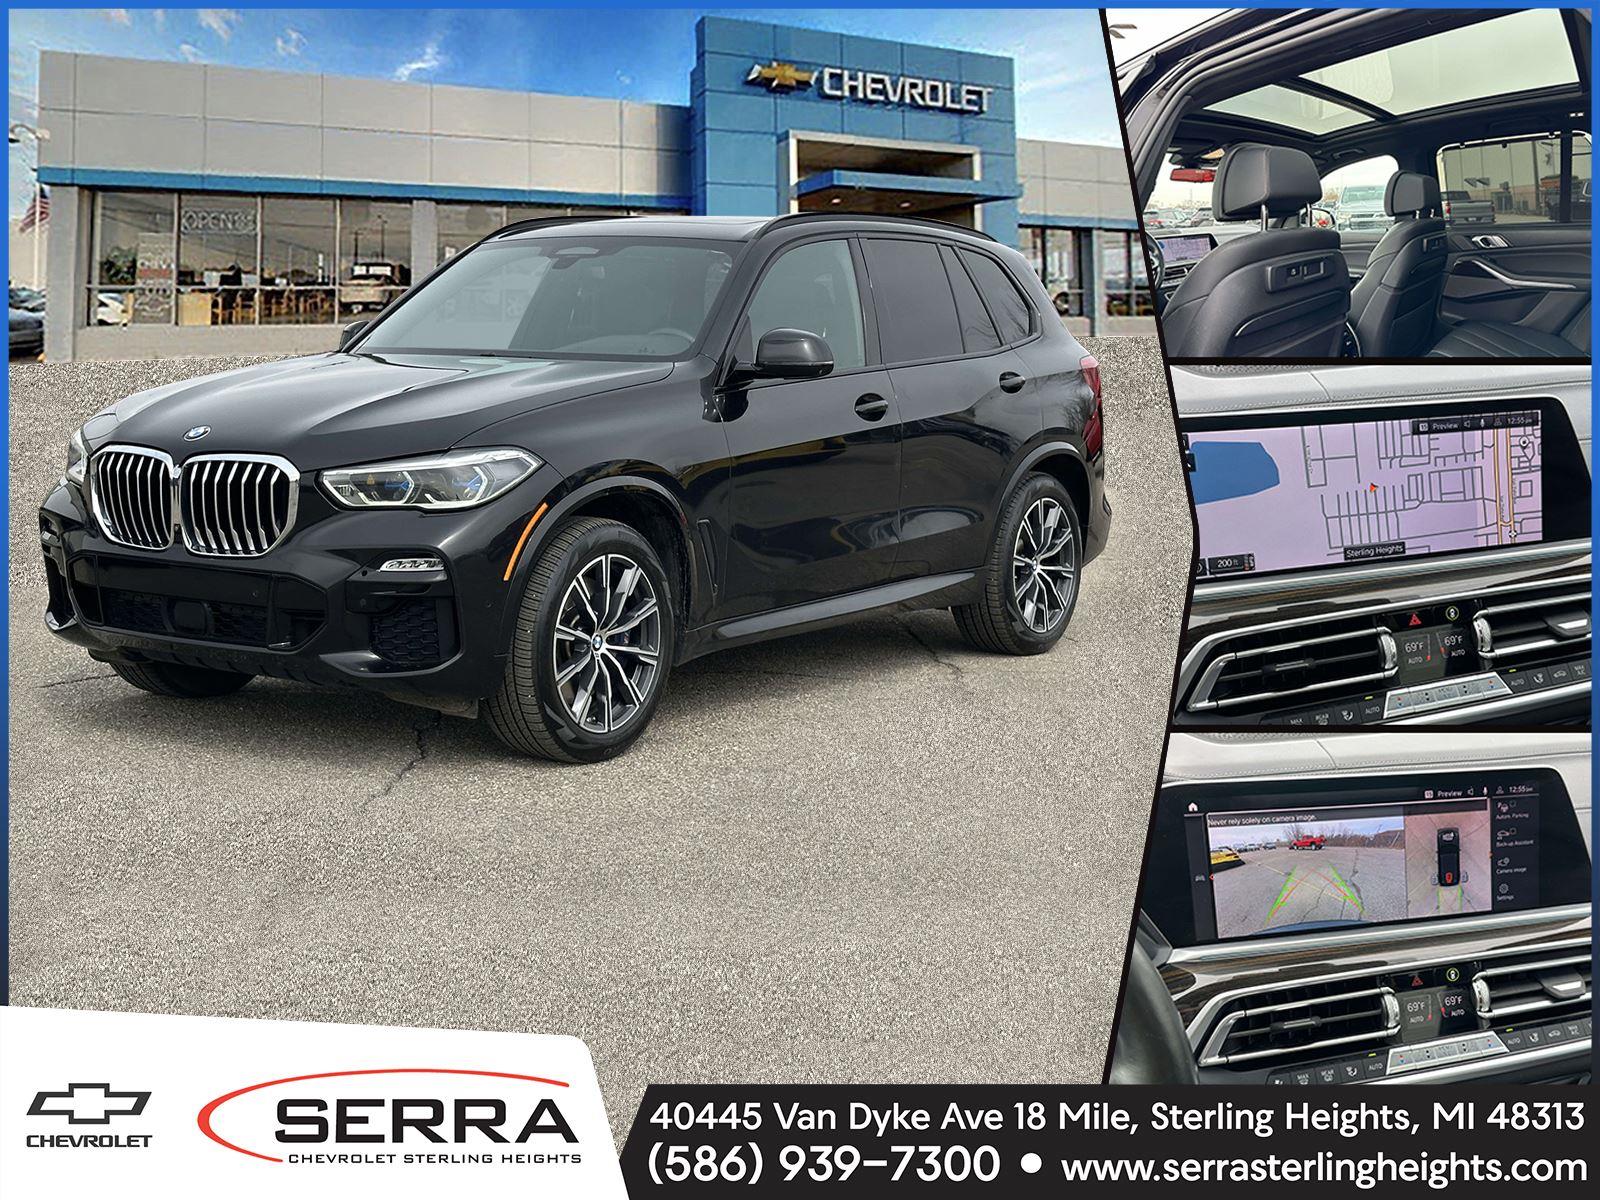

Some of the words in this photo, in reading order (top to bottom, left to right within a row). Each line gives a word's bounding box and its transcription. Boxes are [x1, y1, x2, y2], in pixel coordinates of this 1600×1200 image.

[823, 67, 994, 113] CHEVROLET
[1432, 422, 1459, 431] Preview
[1346, 548, 1375, 558] Sterling
[1375, 544, 1404, 555] Heights
[1217, 558, 1233, 568] 200
[1450, 649, 1466, 657] AUTO
[1407, 656, 1424, 664] AUTO
[1365, 706, 1381, 714] AUTO
[1437, 789, 1463, 798] Preview
[1208, 818, 1227, 826] Never
[1228, 817, 1241, 826] rely
[1242, 815, 1261, 825] solely
[1271, 815, 1295, 823] camera
[1451, 1008, 1466, 1017] AUTO
[1409, 1015, 1425, 1024] AUTO
[1368, 1062, 1383, 1071] AUTO
